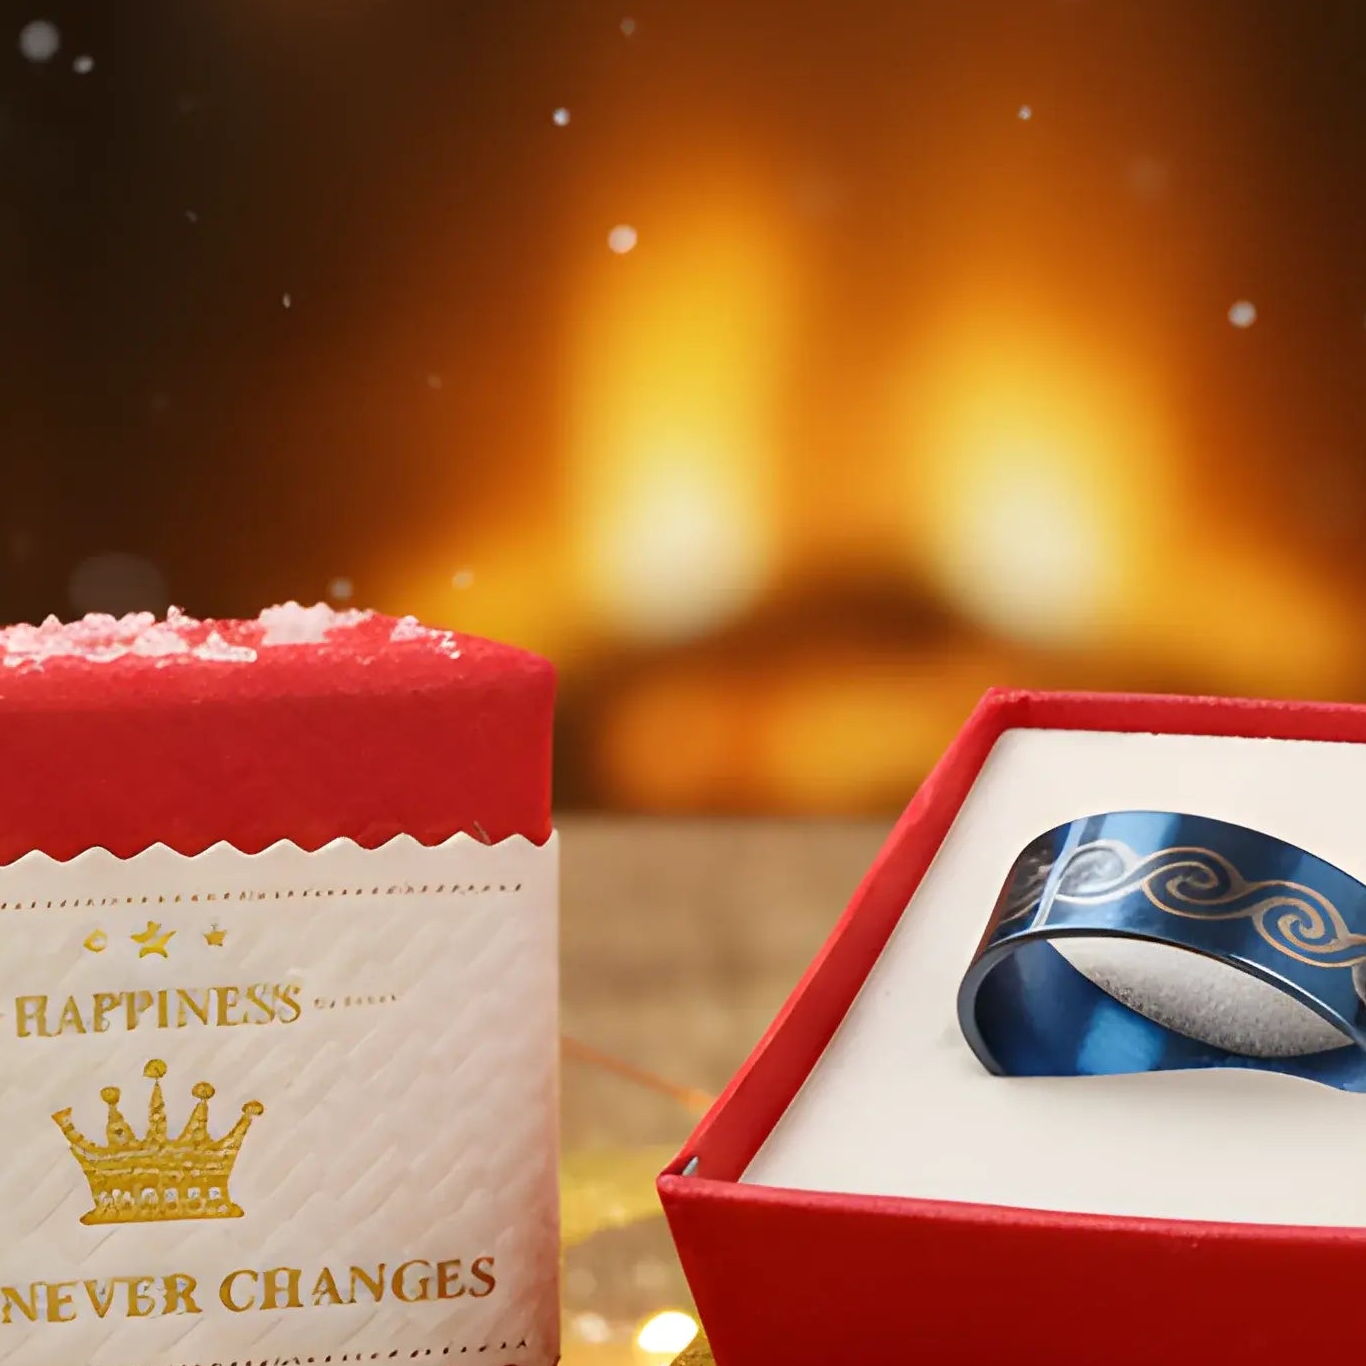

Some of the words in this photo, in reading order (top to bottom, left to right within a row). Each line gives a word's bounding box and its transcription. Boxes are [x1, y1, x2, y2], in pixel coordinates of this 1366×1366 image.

[15, 983, 302, 1038] HAPPINESS
[1, 1273, 202, 1324] NEVER
[219, 1257, 497, 1313] CHANGES
